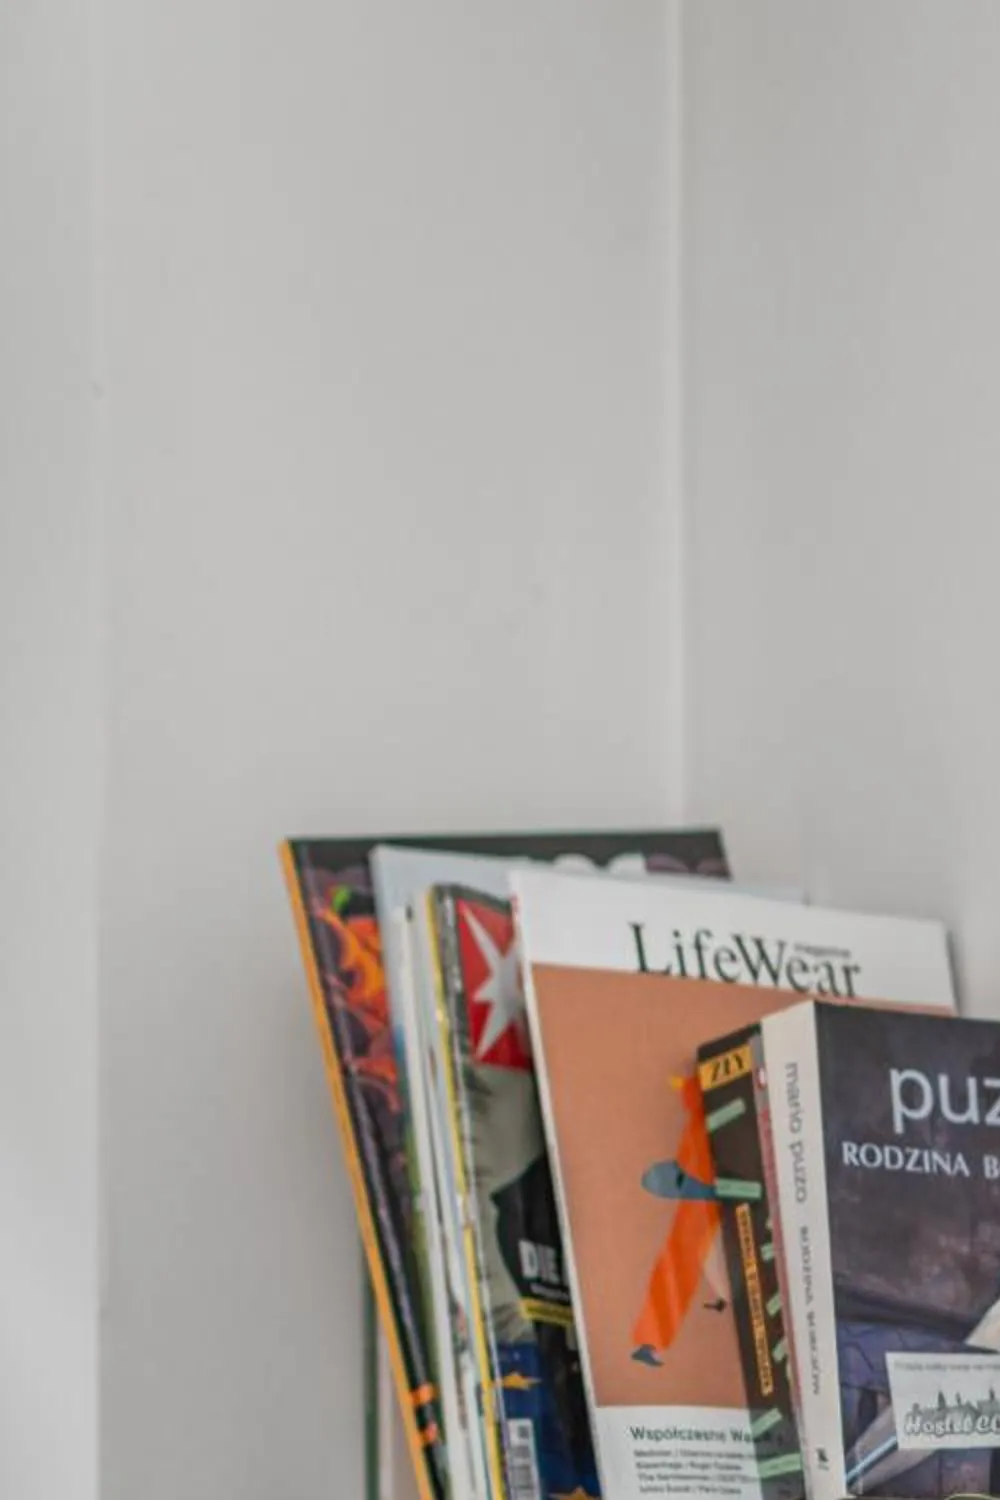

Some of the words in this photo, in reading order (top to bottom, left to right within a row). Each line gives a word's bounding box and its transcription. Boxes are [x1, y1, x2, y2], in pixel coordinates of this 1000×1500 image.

[627, 921, 862, 999] LifeWear
[788, 1140, 808, 1204] puzo
[841, 1140, 971, 1179] RODZINA
